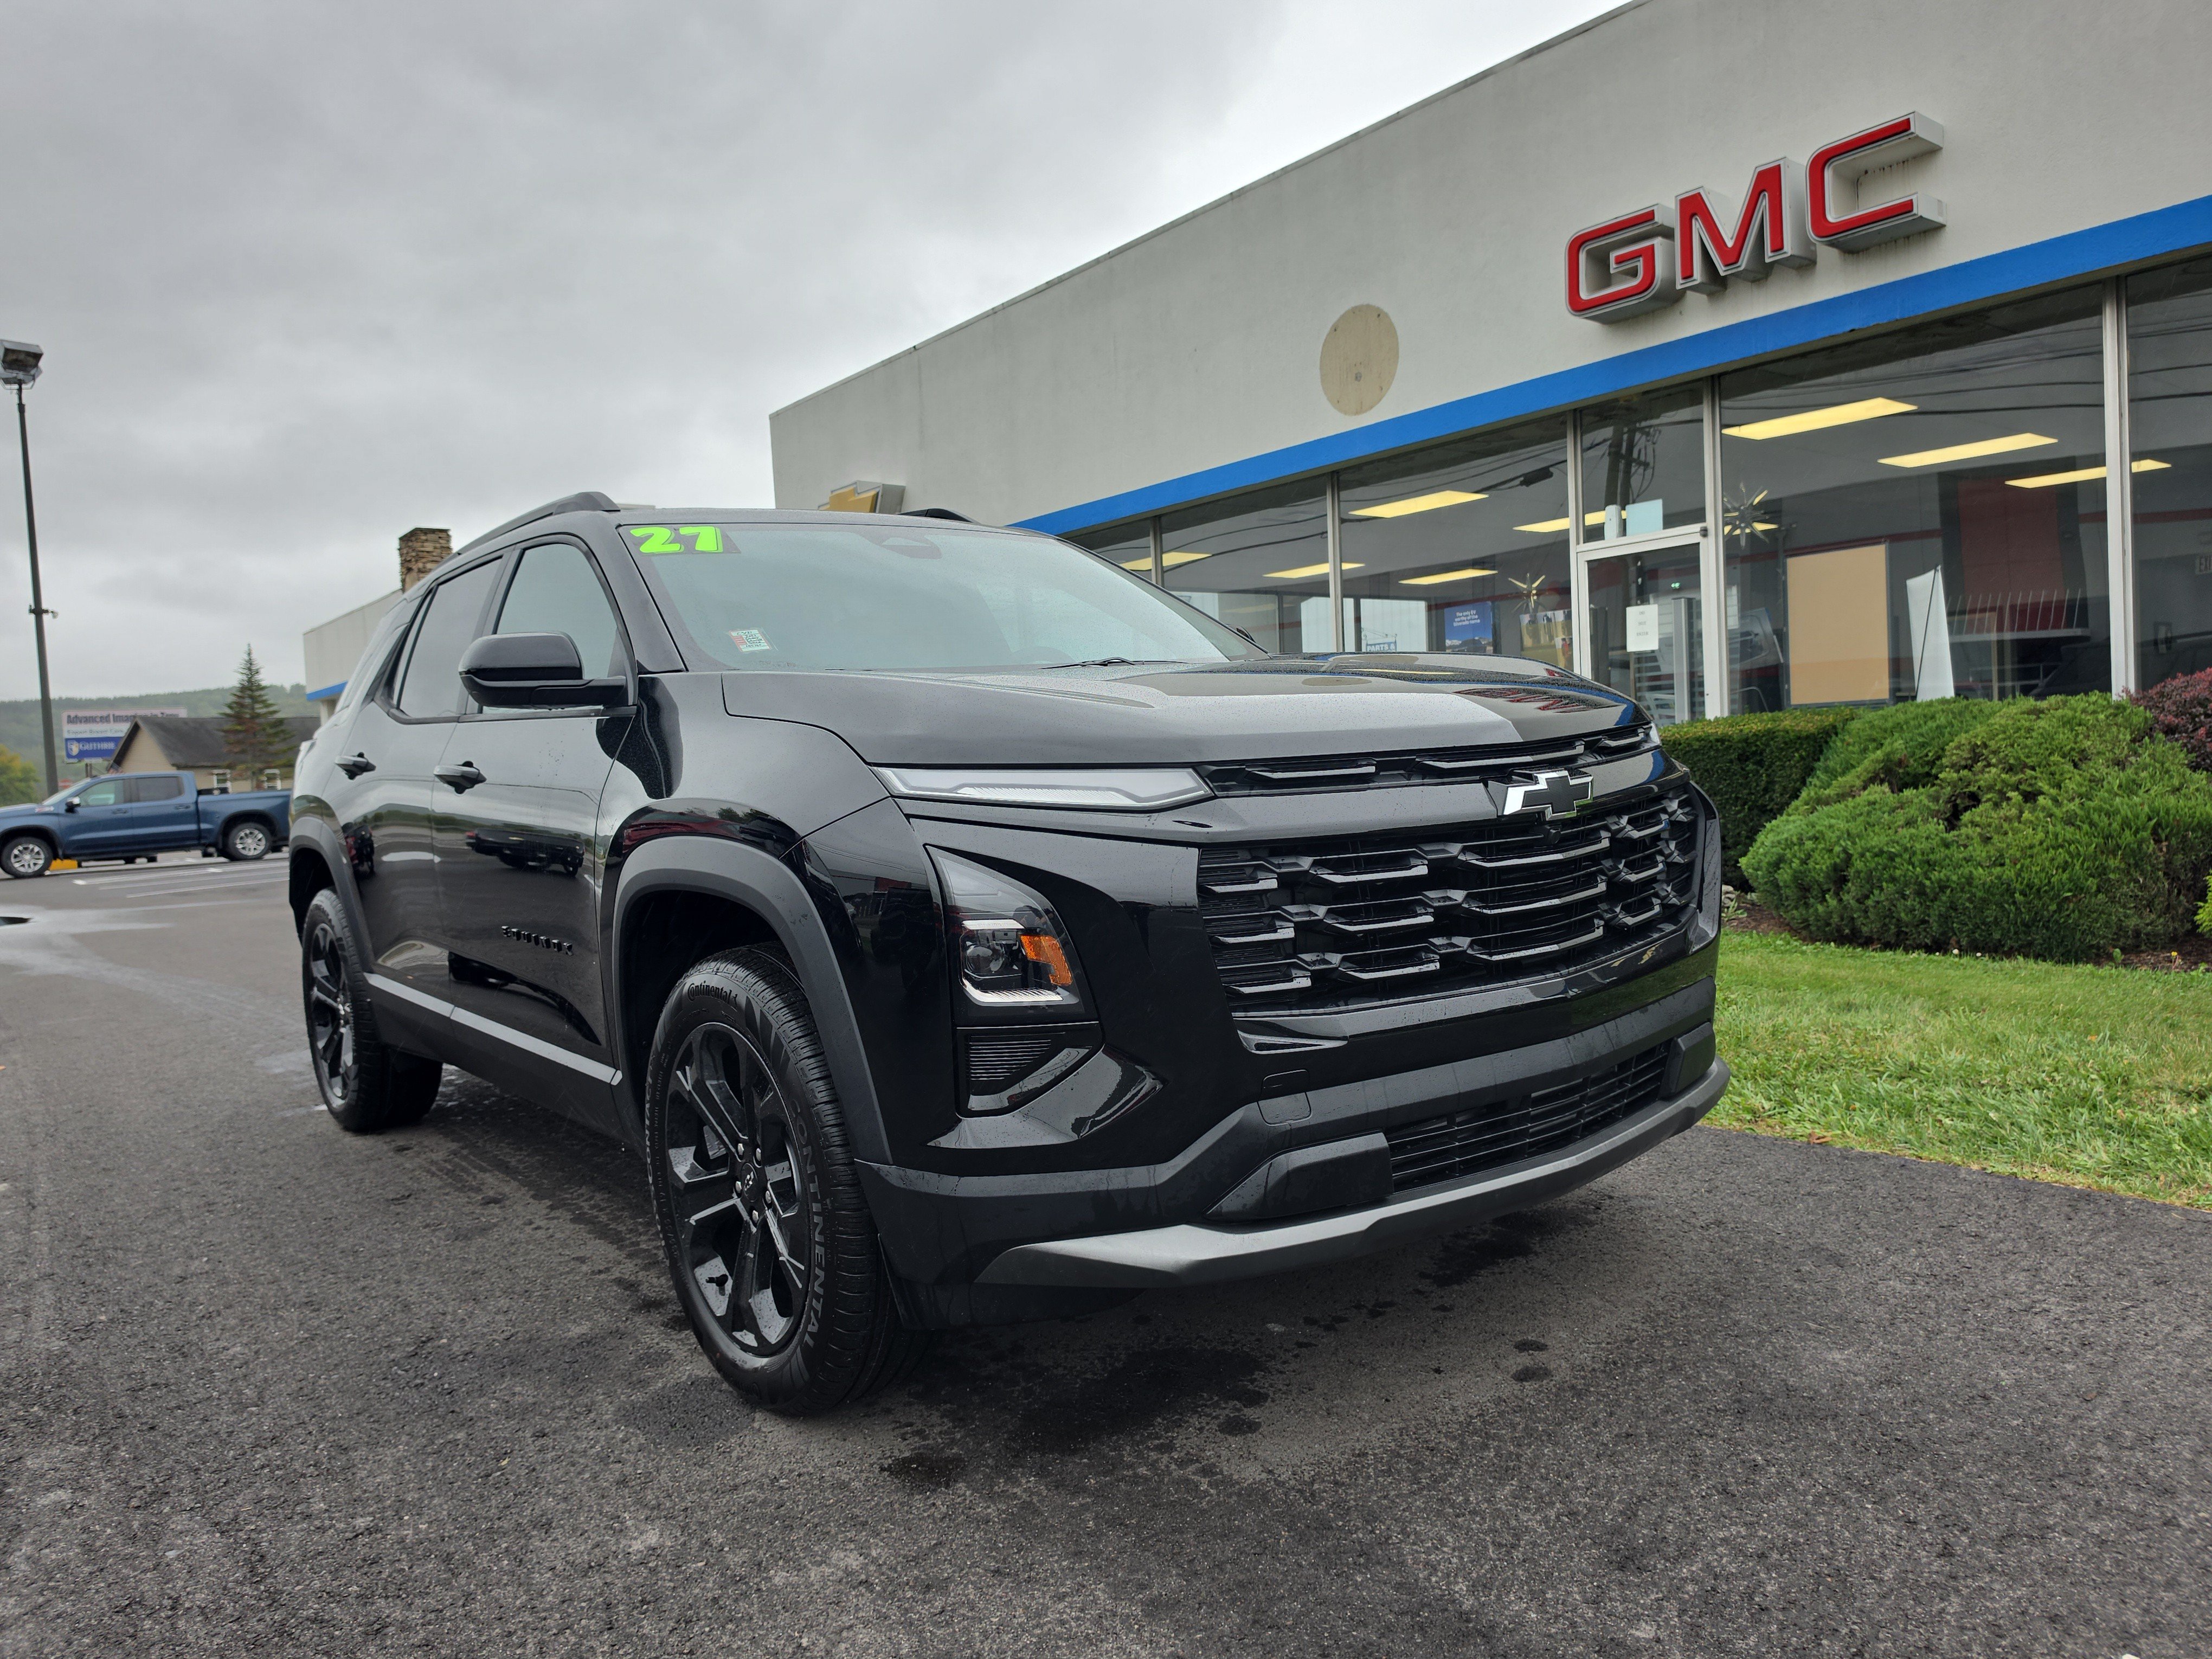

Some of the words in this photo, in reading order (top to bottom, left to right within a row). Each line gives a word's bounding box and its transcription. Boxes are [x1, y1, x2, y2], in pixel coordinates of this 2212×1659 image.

[1565, 111, 1925, 318] GMC
[630, 526, 723, 554] 27
[1367, 643, 1388, 651] PARTS
[67, 715, 111, 724] Advanced
[687, 980, 732, 1005] Continental
[788, 1098, 825, 1349] CONTINENTAL
